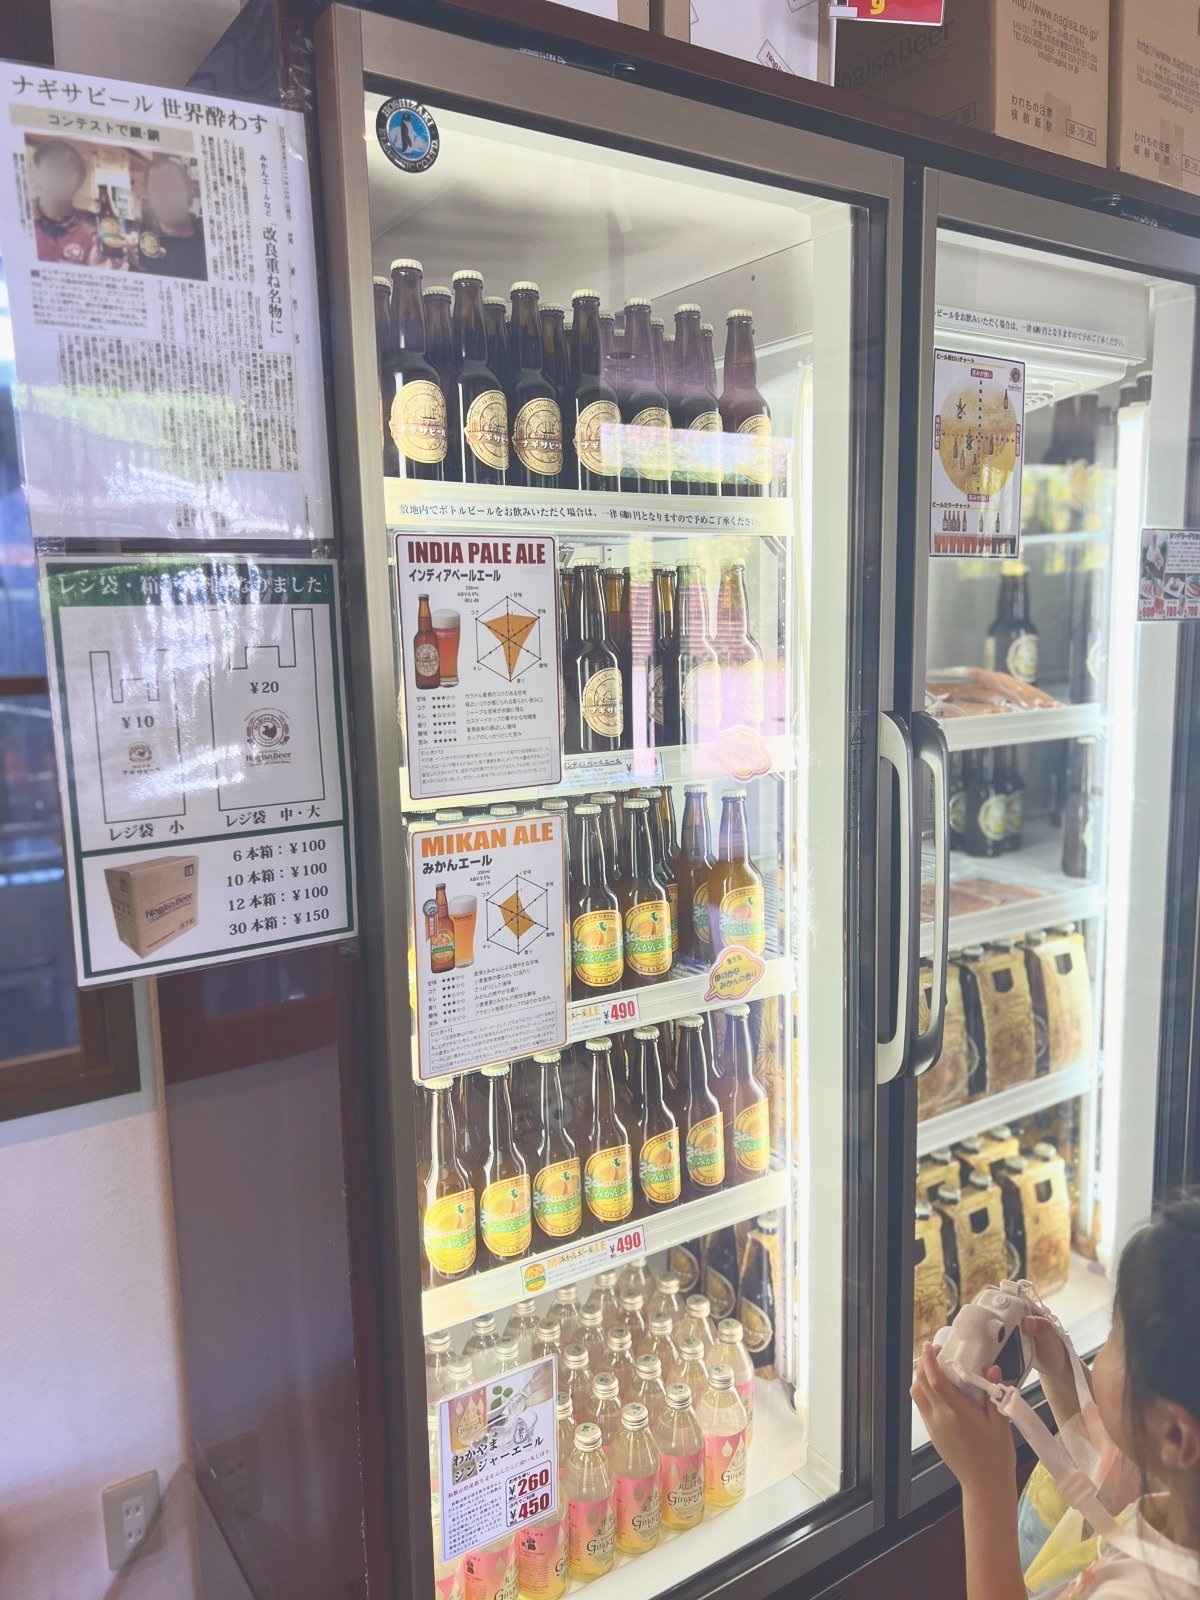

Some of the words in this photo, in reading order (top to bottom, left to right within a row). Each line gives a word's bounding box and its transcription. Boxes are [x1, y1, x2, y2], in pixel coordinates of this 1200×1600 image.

[12, 75, 154, 113] ナギサビール
[161, 97, 268, 135] 世界酔わす
[382, 98, 434, 126] HOSHIZAKI
[1011, 95, 1053, 118] われもの注意
[1134, 131, 1170, 153] われもの注意
[260, 154, 272, 217] みかんエールなど
[262, 223, 283, 338] 「改良重ね名物に」
[408, 541, 464, 564] INDIA
[468, 542, 512, 564] PALE
[515, 543, 546, 564] ALE
[408, 569, 501, 583] インディアペールエール
[249, 680, 280, 695] ¥20
[121, 715, 155, 730] ¥10
[225, 810, 267, 828] レジ袋
[280, 804, 321, 821] 中・大
[109, 822, 154, 842] レジ袋
[169, 820, 185, 835] 小
[421, 828, 507, 858] MIKAN
[513, 822, 554, 846] ALE
[422, 854, 493, 875] みかんエール
[610, 1231, 641, 1255] ¥490
[453, 1438, 498, 1467] わかやま
[454, 1436, 544, 1483] ジンジャーエール
[509, 1468, 550, 1497] ¥260
[510, 1493, 550, 1520] ¥450
